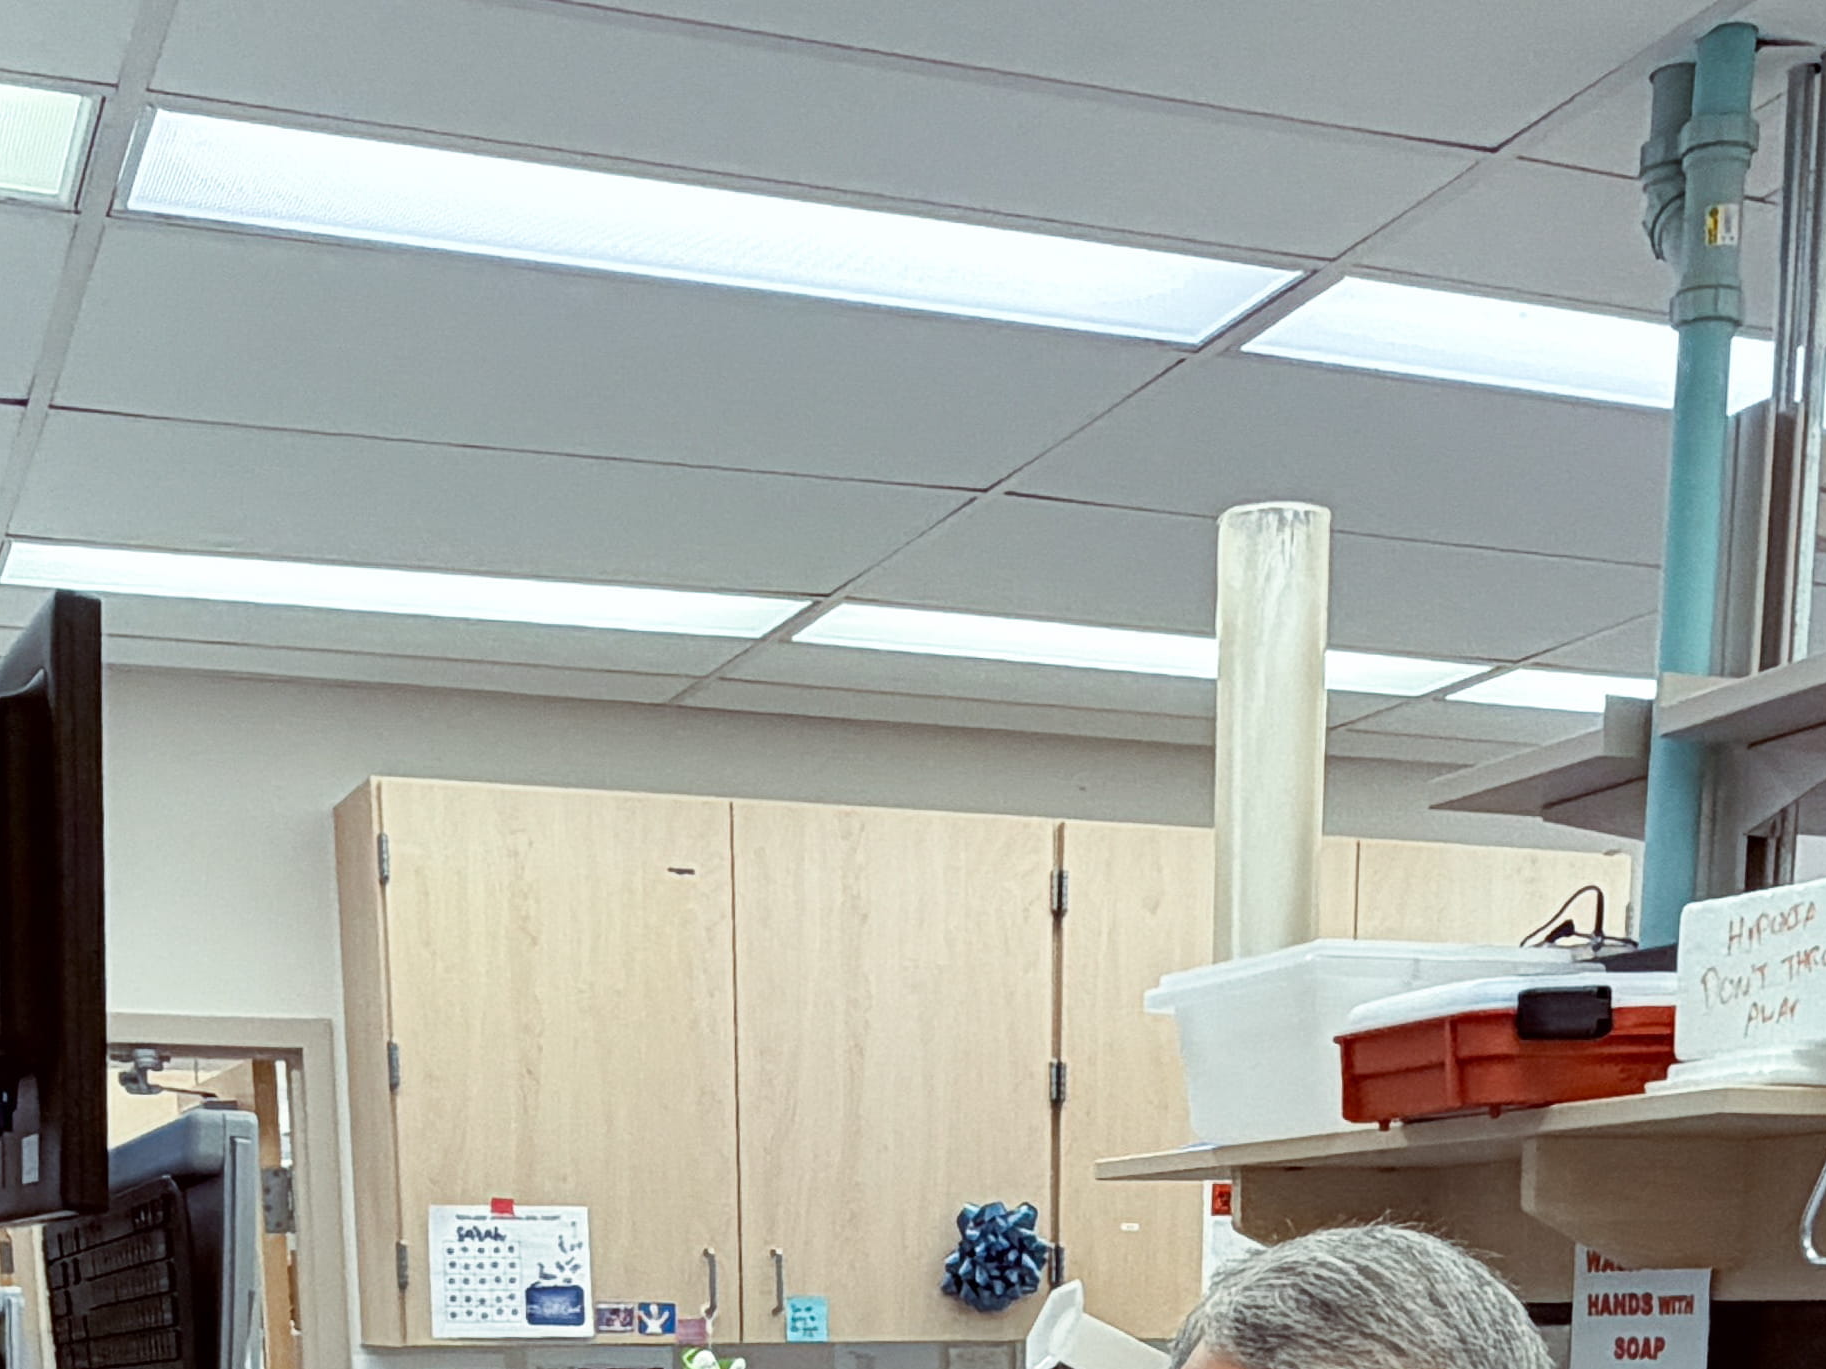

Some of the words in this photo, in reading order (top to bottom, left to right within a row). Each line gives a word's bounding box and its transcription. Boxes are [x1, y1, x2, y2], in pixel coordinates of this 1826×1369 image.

[1700, 965, 1770, 1009] DON'T
[1587, 1292, 1654, 1317] HANDS
[1658, 1294, 1695, 1316] WITH
[1614, 1336, 1666, 1360] SOAP
